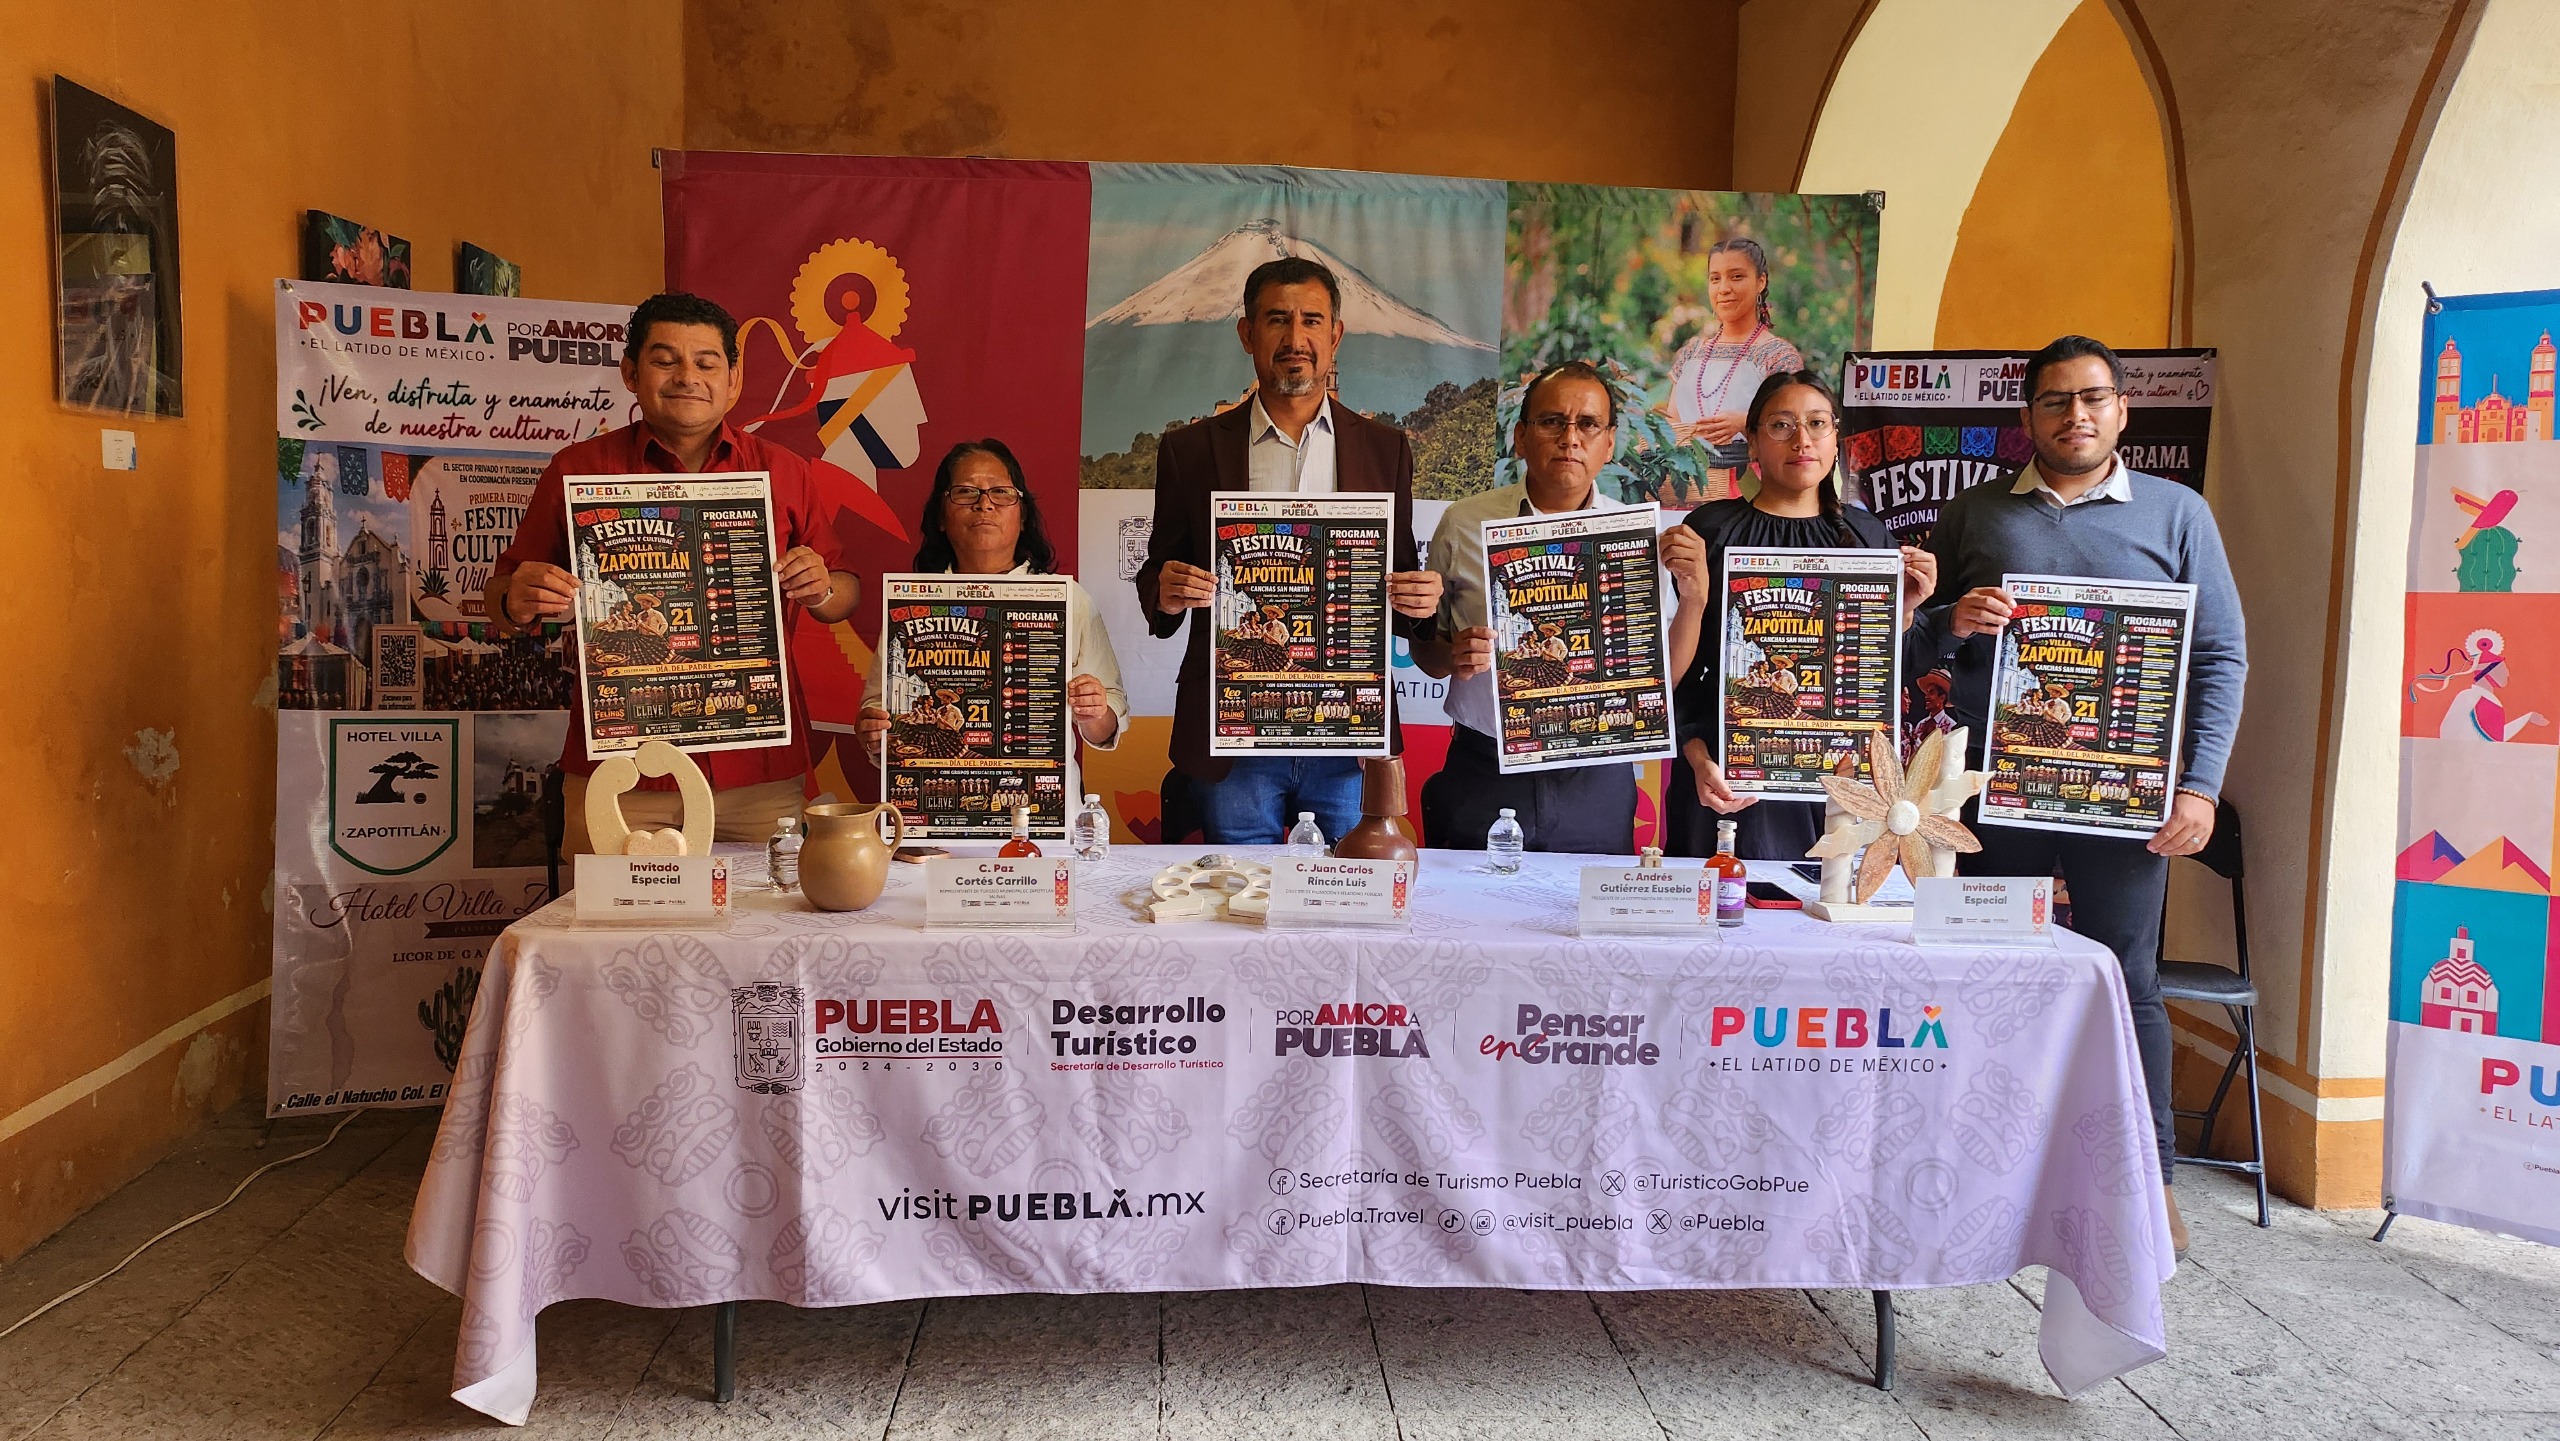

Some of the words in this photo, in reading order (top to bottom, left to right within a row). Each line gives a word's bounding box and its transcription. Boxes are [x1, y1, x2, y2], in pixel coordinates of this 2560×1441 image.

[300, 301, 494, 344] PUEBLA
[508, 322, 542, 336] POR
[542, 320, 627, 342] AMOR
[311, 339, 327, 349] EL
[336, 341, 391, 355] LATIDO
[399, 346, 418, 357] DE
[426, 347, 485, 361] MÉXICO
[509, 337, 619, 367] PUEBL
[1855, 365, 1951, 389] PUEBLA
[1980, 368, 1999, 378] POR
[2148, 372, 2154, 384] y
[2158, 367, 2203, 379] enamórate
[319, 375, 378, 406] ¡Ven,
[388, 377, 476, 410] disfruta
[484, 396, 500, 420] y
[509, 387, 614, 411] enamórate
[1914, 391, 1945, 401] MÉXICO
[2147, 384, 2182, 397] cultura!
[365, 411, 391, 434] de
[400, 412, 480, 438] nuestra
[490, 417, 579, 442] cultura!
[2119, 446, 2190, 468] GRAMA
[444, 463, 450, 471] EL
[452, 464, 473, 472] SECTOR
[475, 465, 498, 473] PRIVADO
[505, 466, 529, 474] TURISMO
[469, 475, 510, 484] COORDINACIÓN
[469, 493, 505, 505] PRIMERA
[577, 486, 632, 496] PUEBLA
[703, 511, 758, 520] PROGRAMA
[1221, 503, 1268, 512] PUEBLA
[465, 507, 526, 531] FESTIV
[592, 519, 675, 540] FESTIVAL
[1330, 530, 1380, 538] PROGRAMA
[628, 543, 653, 552] VILLA
[1231, 535, 1303, 554] FESTIVAL
[1601, 539, 1649, 552] PROGRAMA
[599, 549, 690, 573] ZAPOTITLÁN
[1504, 555, 1576, 578] FESTIVAL
[1734, 558, 1780, 566] PUEBLA
[455, 566, 490, 594] Vill
[1234, 566, 1314, 585] ZAPOTITLÁN
[1534, 578, 1556, 586] VILLA
[894, 584, 943, 593] PUEBLA
[1509, 581, 1588, 607] ZAPOTITLÁN
[1840, 584, 1890, 593] PROGRAMA
[2013, 585, 2061, 595] PUEBLA
[1743, 588, 1814, 607] FESTIVAL
[467, 603, 485, 613] VILLA
[1007, 612, 1059, 621] PROGRAMA
[670, 608, 694, 626] 21
[2123, 616, 2177, 628] PROGRAMA
[905, 617, 979, 636] FESTIVAL
[1292, 621, 1313, 637] 21
[1744, 616, 1824, 637] ZAPOTITLÁN
[2021, 616, 2095, 637] FESTIVAL
[1570, 634, 1590, 651] 21
[2049, 639, 2072, 647] VILLA
[907, 648, 990, 669] ZAPOTITLÁN
[2019, 643, 2104, 668] ZAPOTITLÁN
[751, 682, 778, 691] SEVEN
[1801, 670, 1821, 687] 21
[968, 705, 989, 722] 21
[2074, 700, 2096, 717] 21
[347, 732, 396, 742] HOTEL
[401, 732, 442, 742] VILLA
[347, 824, 440, 838] ZAPOTITLÁN
[630, 862, 679, 872] Invitado
[979, 864, 991, 873] C.
[994, 864, 1014, 873] Paz
[1296, 864, 1307, 872] C.
[1310, 864, 1336, 873] Juan
[1339, 865, 1373, 874] Carlos
[632, 875, 680, 886] Especial
[956, 876, 993, 886] Cortés
[996, 876, 1037, 886] Carrillo
[1308, 877, 1343, 887] Rincón
[1346, 878, 1366, 887] Luis
[1636, 873, 1672, 881] Andrés
[1600, 883, 1649, 893] Gutiérrez
[1652, 884, 1692, 893] Eusebio
[1962, 883, 2006, 892] Invitada
[310, 888, 420, 928] Hotel
[422, 883, 505, 920] Villa
[1965, 896, 2007, 906] Especial
[392, 952, 433, 962] LICOR
[437, 951, 455, 960] DE
[815, 999, 1002, 1034] PUEBLA
[1052, 996, 1226, 1025] Desarrollo
[1276, 1010, 1315, 1026] POR
[1314, 1003, 1409, 1026] AMOR
[1409, 1013, 1420, 1026] A
[1516, 1004, 1645, 1037] Pensar
[1710, 1005, 1949, 1048] PUEBLA
[815, 1036, 902, 1054] Gobierno
[906, 1037, 934, 1054] del
[939, 1037, 1003, 1054] Estado
[1051, 1030, 1196, 1057] Turístico
[1275, 1027, 1430, 1058] PUEBLA
[1479, 1033, 1524, 1061] en
[1520, 1033, 1660, 1065] Grande
[1050, 1060, 1104, 1072] Secretaría
[1106, 1060, 1120, 1071] de
[1123, 1059, 1177, 1070] Desarrollo
[1179, 1059, 1224, 1069] Turístico
[1722, 1057, 1742, 1071] EL
[1752, 1057, 1820, 1072] LATIDO
[1830, 1059, 1853, 1073] DE
[1862, 1055, 1934, 1073] MÉXICO
[287, 1093, 321, 1108] Calle
[325, 1091, 339, 1106] el
[341, 1088, 397, 1105] Natucho
[401, 1086, 425, 1100] Col.
[429, 1084, 444, 1098] El
[2494, 1106, 2517, 1123] EL
[1299, 1168, 1397, 1188] Secretaría
[1404, 1171, 1429, 1188] de
[1436, 1173, 1508, 1190] Turismo
[1515, 1172, 1581, 1189] Puebla
[1634, 1174, 1809, 1192] @TuristicoGobPue
[1299, 1207, 1424, 1229] Puebla.Travel
[1502, 1212, 1633, 1232] @visit_puebla
[1680, 1213, 1765, 1232] @Puebla
